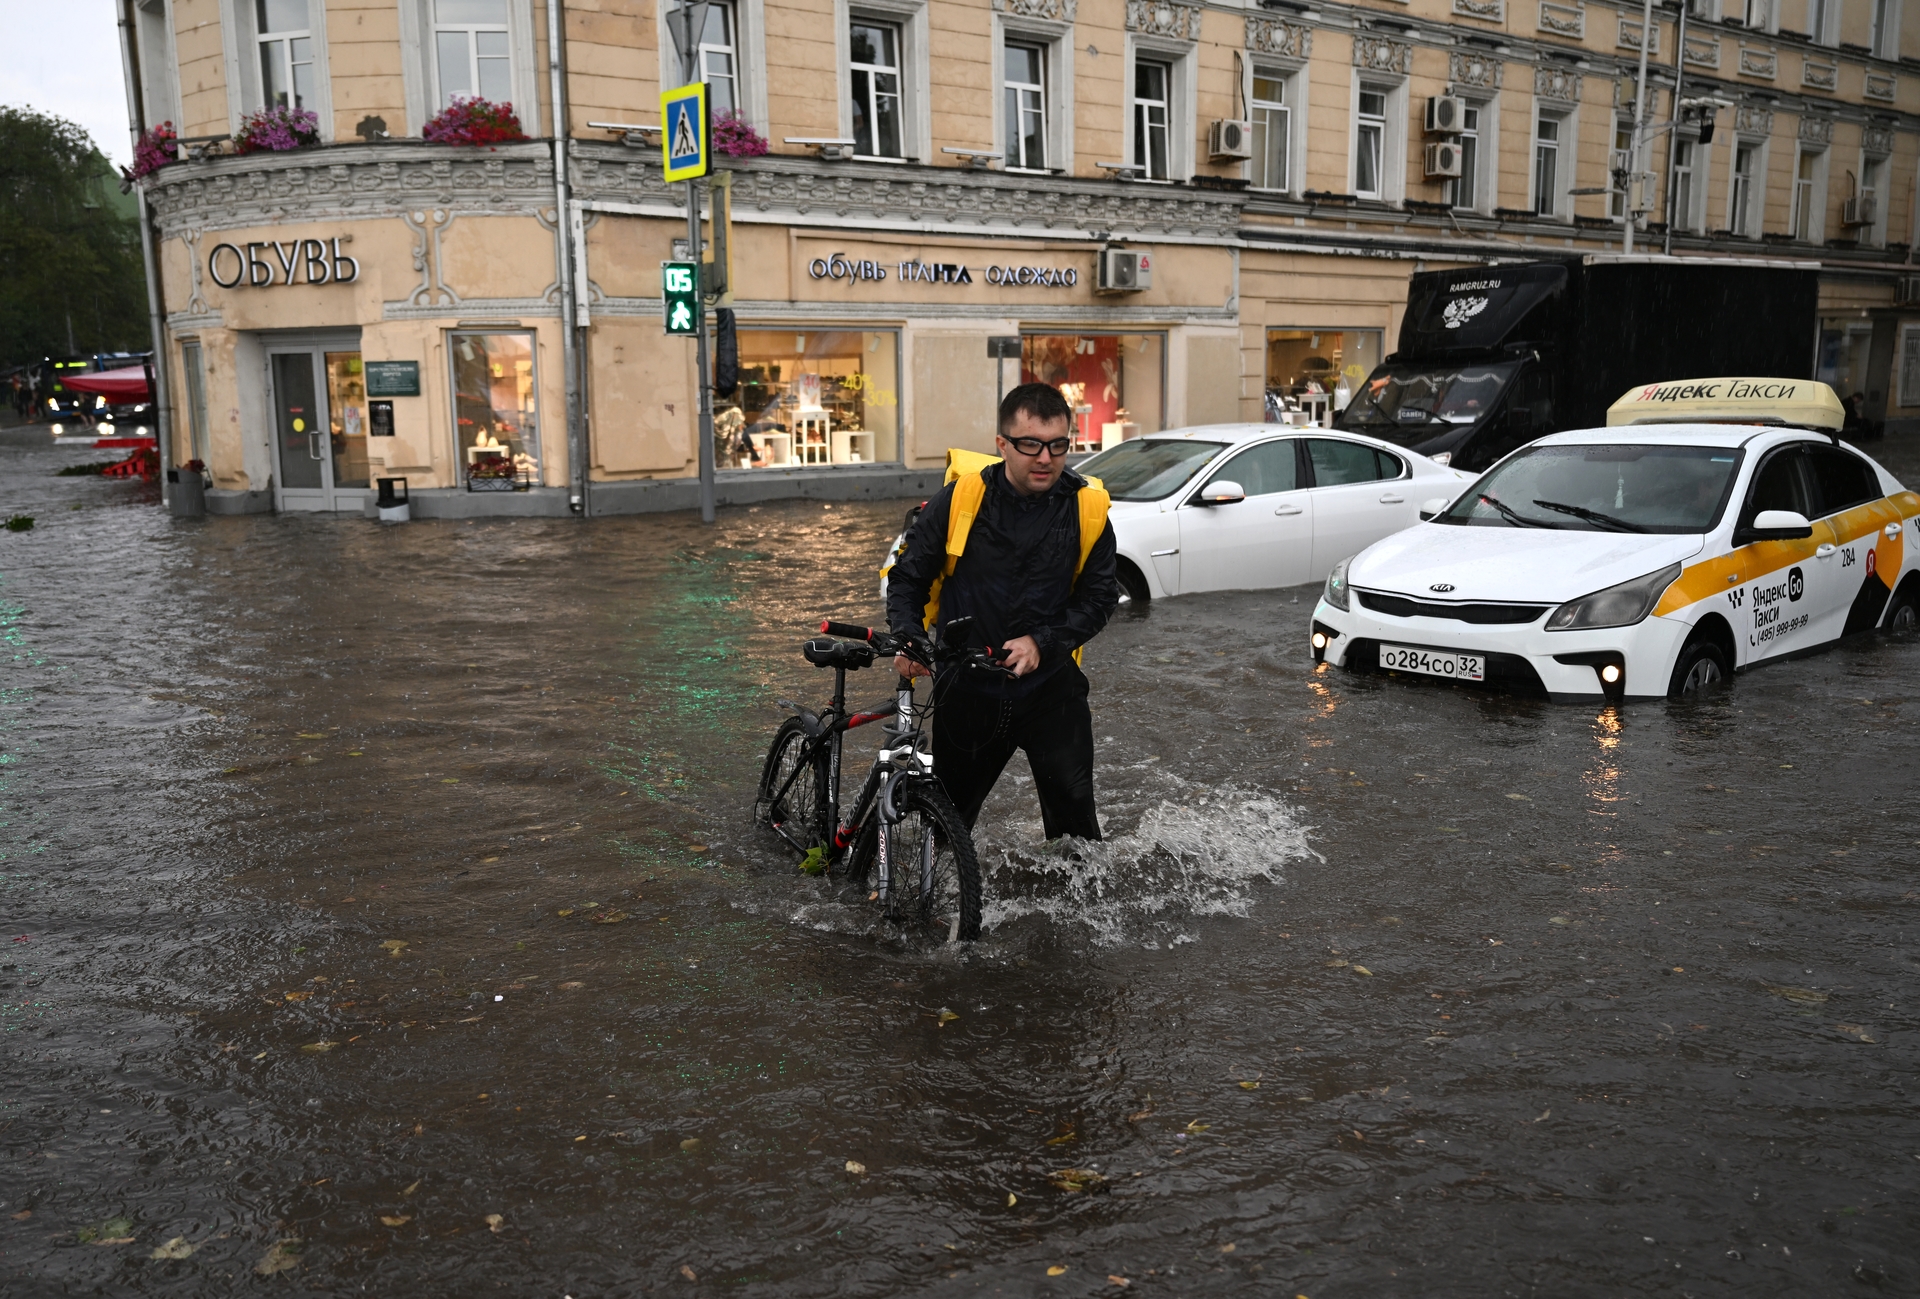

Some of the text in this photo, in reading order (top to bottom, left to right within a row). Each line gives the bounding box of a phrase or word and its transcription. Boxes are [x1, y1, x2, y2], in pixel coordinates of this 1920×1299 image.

[208, 237, 360, 289] ОБУВЬ
[665, 268, 693, 292] 05
[1449, 279, 1501, 293] RAMGRUZ.RU
[1636, 380, 1796, 402] Яндекс Такси
[1841, 547, 1856, 568] 284
[1432, 584, 1452, 592] KIA
[1752, 573, 1803, 608] Яндекс Go
[1753, 605, 1780, 630] Такси
[1757, 613, 1808, 646] (495) 999-99-99
[1458, 670, 1472, 678] RUS
[1459, 657, 1478, 673] 32
[879, 830, 887, 864] ZOOM
